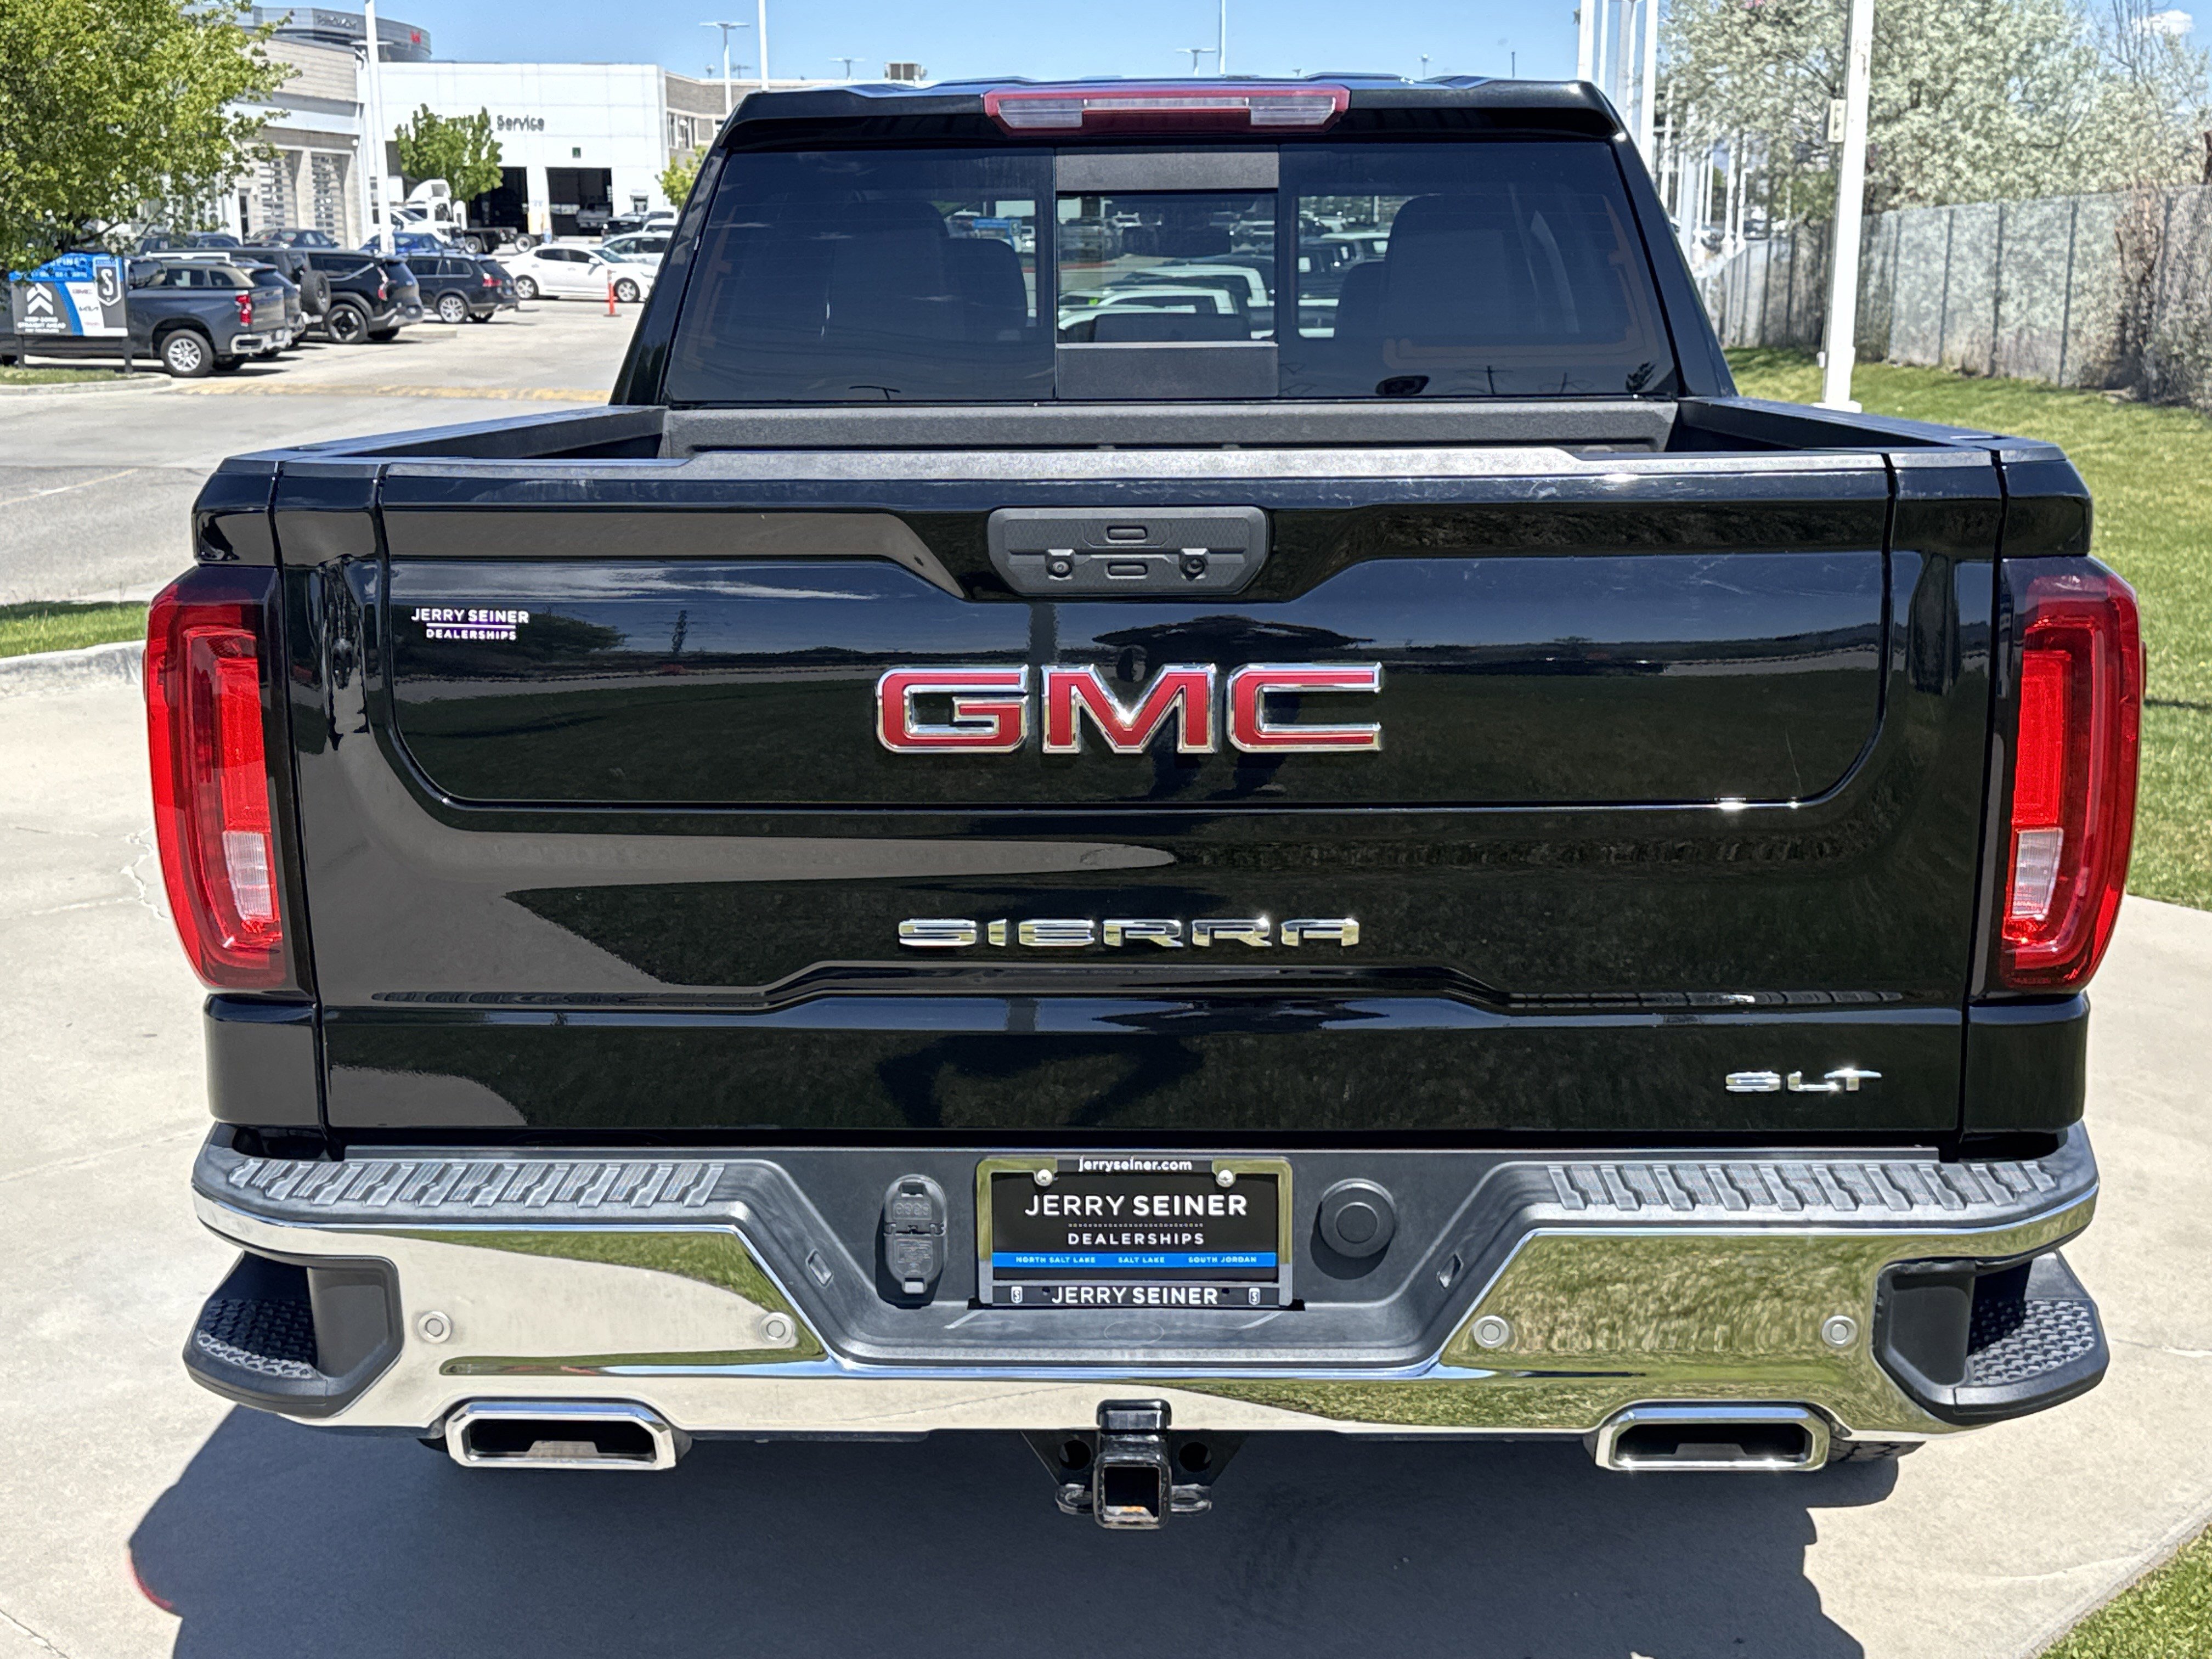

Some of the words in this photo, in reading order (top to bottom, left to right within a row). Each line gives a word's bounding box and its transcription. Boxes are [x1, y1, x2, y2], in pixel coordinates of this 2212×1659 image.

[497, 114, 545, 131] Service
[411, 608, 465, 622] JERRY
[468, 610, 529, 624] SEINER
[426, 629, 516, 640] DEALERSHIPS
[876, 663, 1383, 754] GMC
[898, 917, 1360, 947] SIERRA
[1725, 1069, 1882, 1092] SLT
[1078, 1155, 1193, 1172] jerryseiner.com
[1024, 1194, 1125, 1216] JERRY
[1132, 1195, 1248, 1216] SEINER
[1068, 1233, 1205, 1245] DEALERSHIPS
[1052, 1286, 1127, 1304] JERRY
[1132, 1287, 1218, 1304] SEINER
